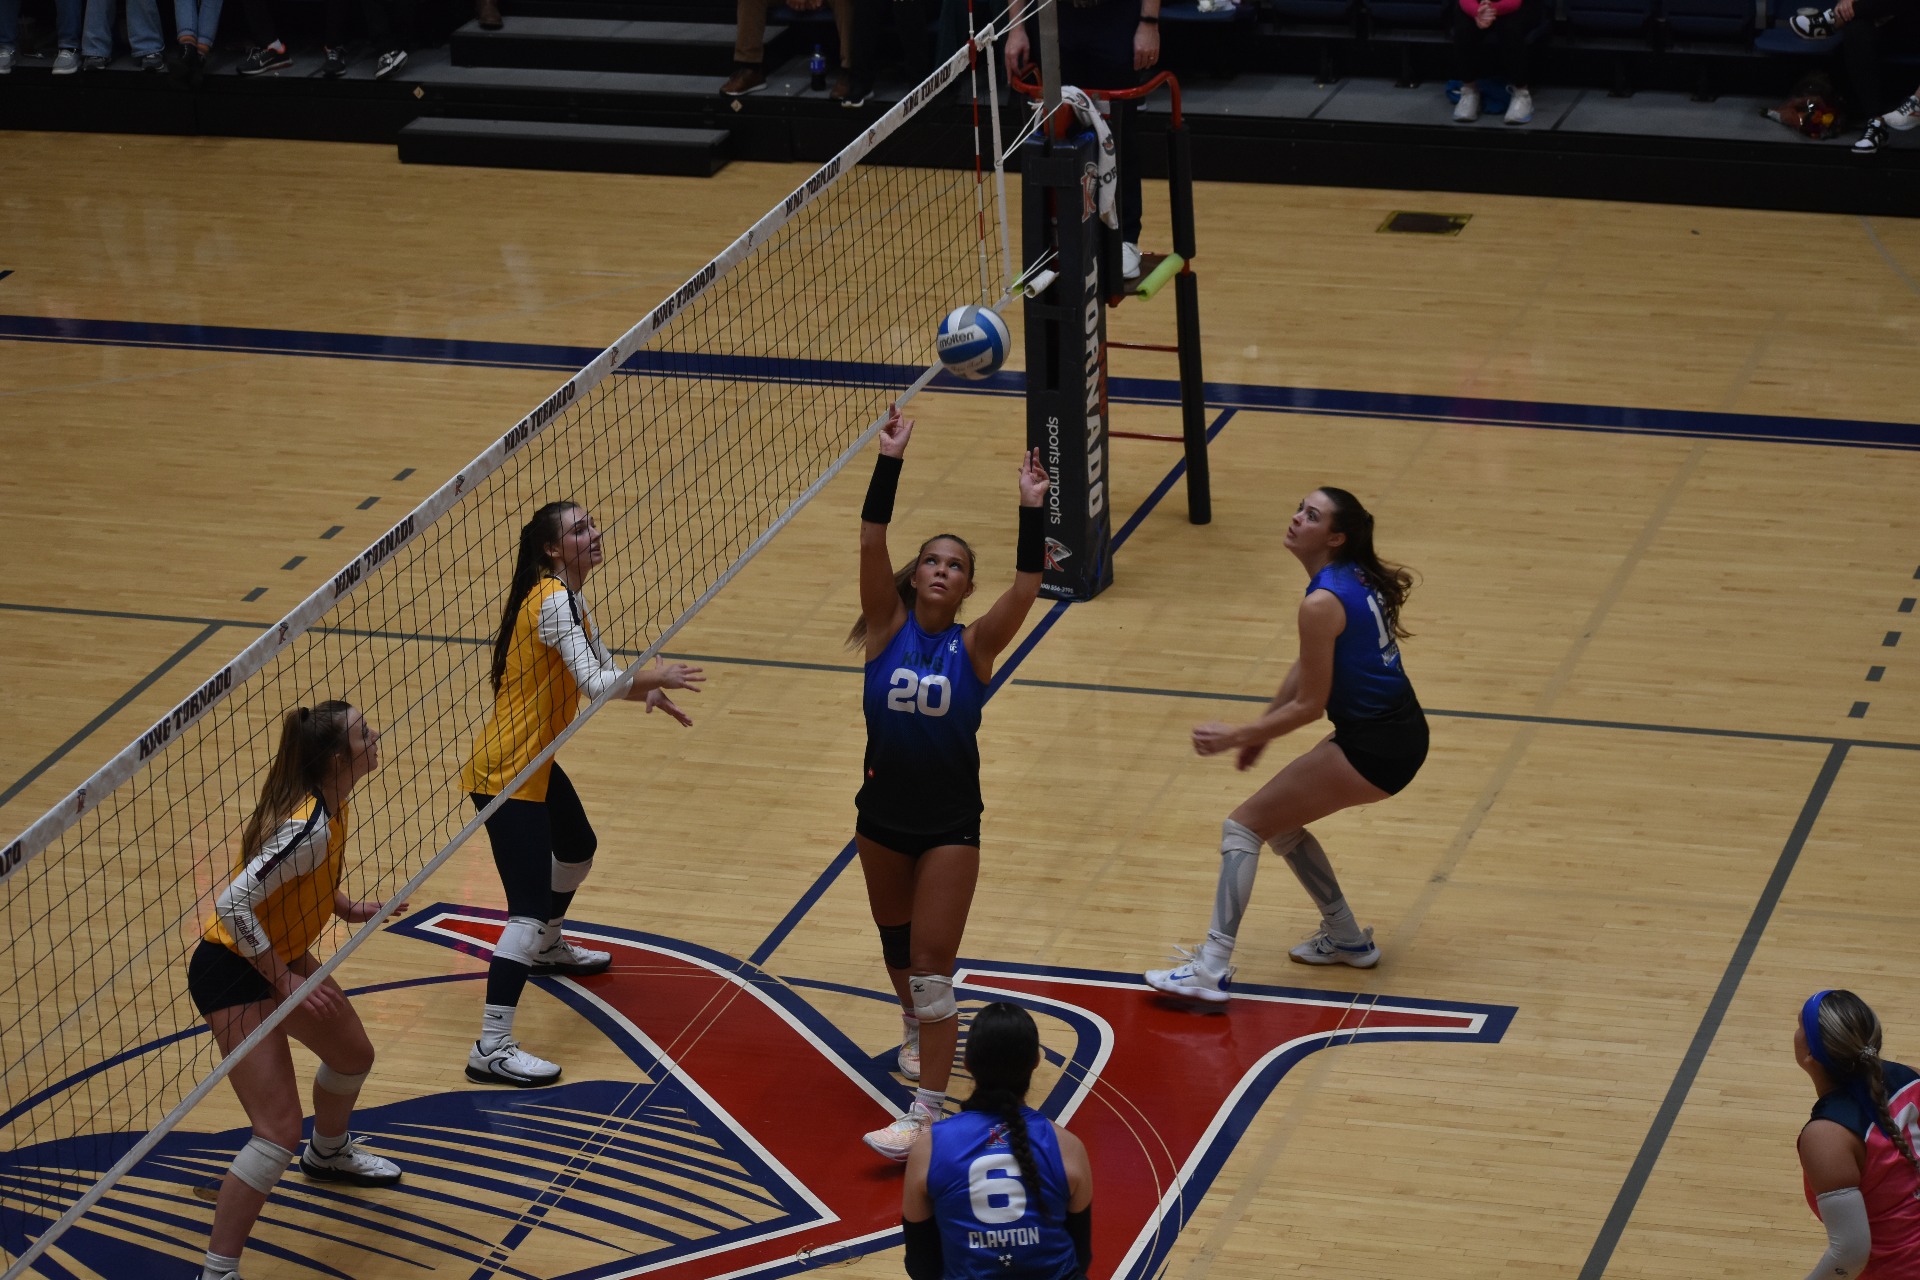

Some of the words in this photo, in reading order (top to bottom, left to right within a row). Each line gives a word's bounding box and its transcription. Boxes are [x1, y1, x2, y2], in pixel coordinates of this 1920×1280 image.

[940, 332, 974, 348] molten
[1085, 256, 1103, 518] TORNADO
[504, 419, 529, 454] KING
[530, 380, 576, 432] TORNADO
[1046, 416, 1060, 464] sports
[1048, 466, 1061, 525] imports
[334, 558, 361, 599] KING
[364, 514, 414, 573] TORNADO
[887, 667, 952, 717] 20
[902, 651, 944, 674] KING
[139, 716, 171, 761] KING
[173, 666, 231, 732] TORNADO
[968, 1153, 1028, 1224] 6
[968, 1226, 1040, 1249] CLAYTON
